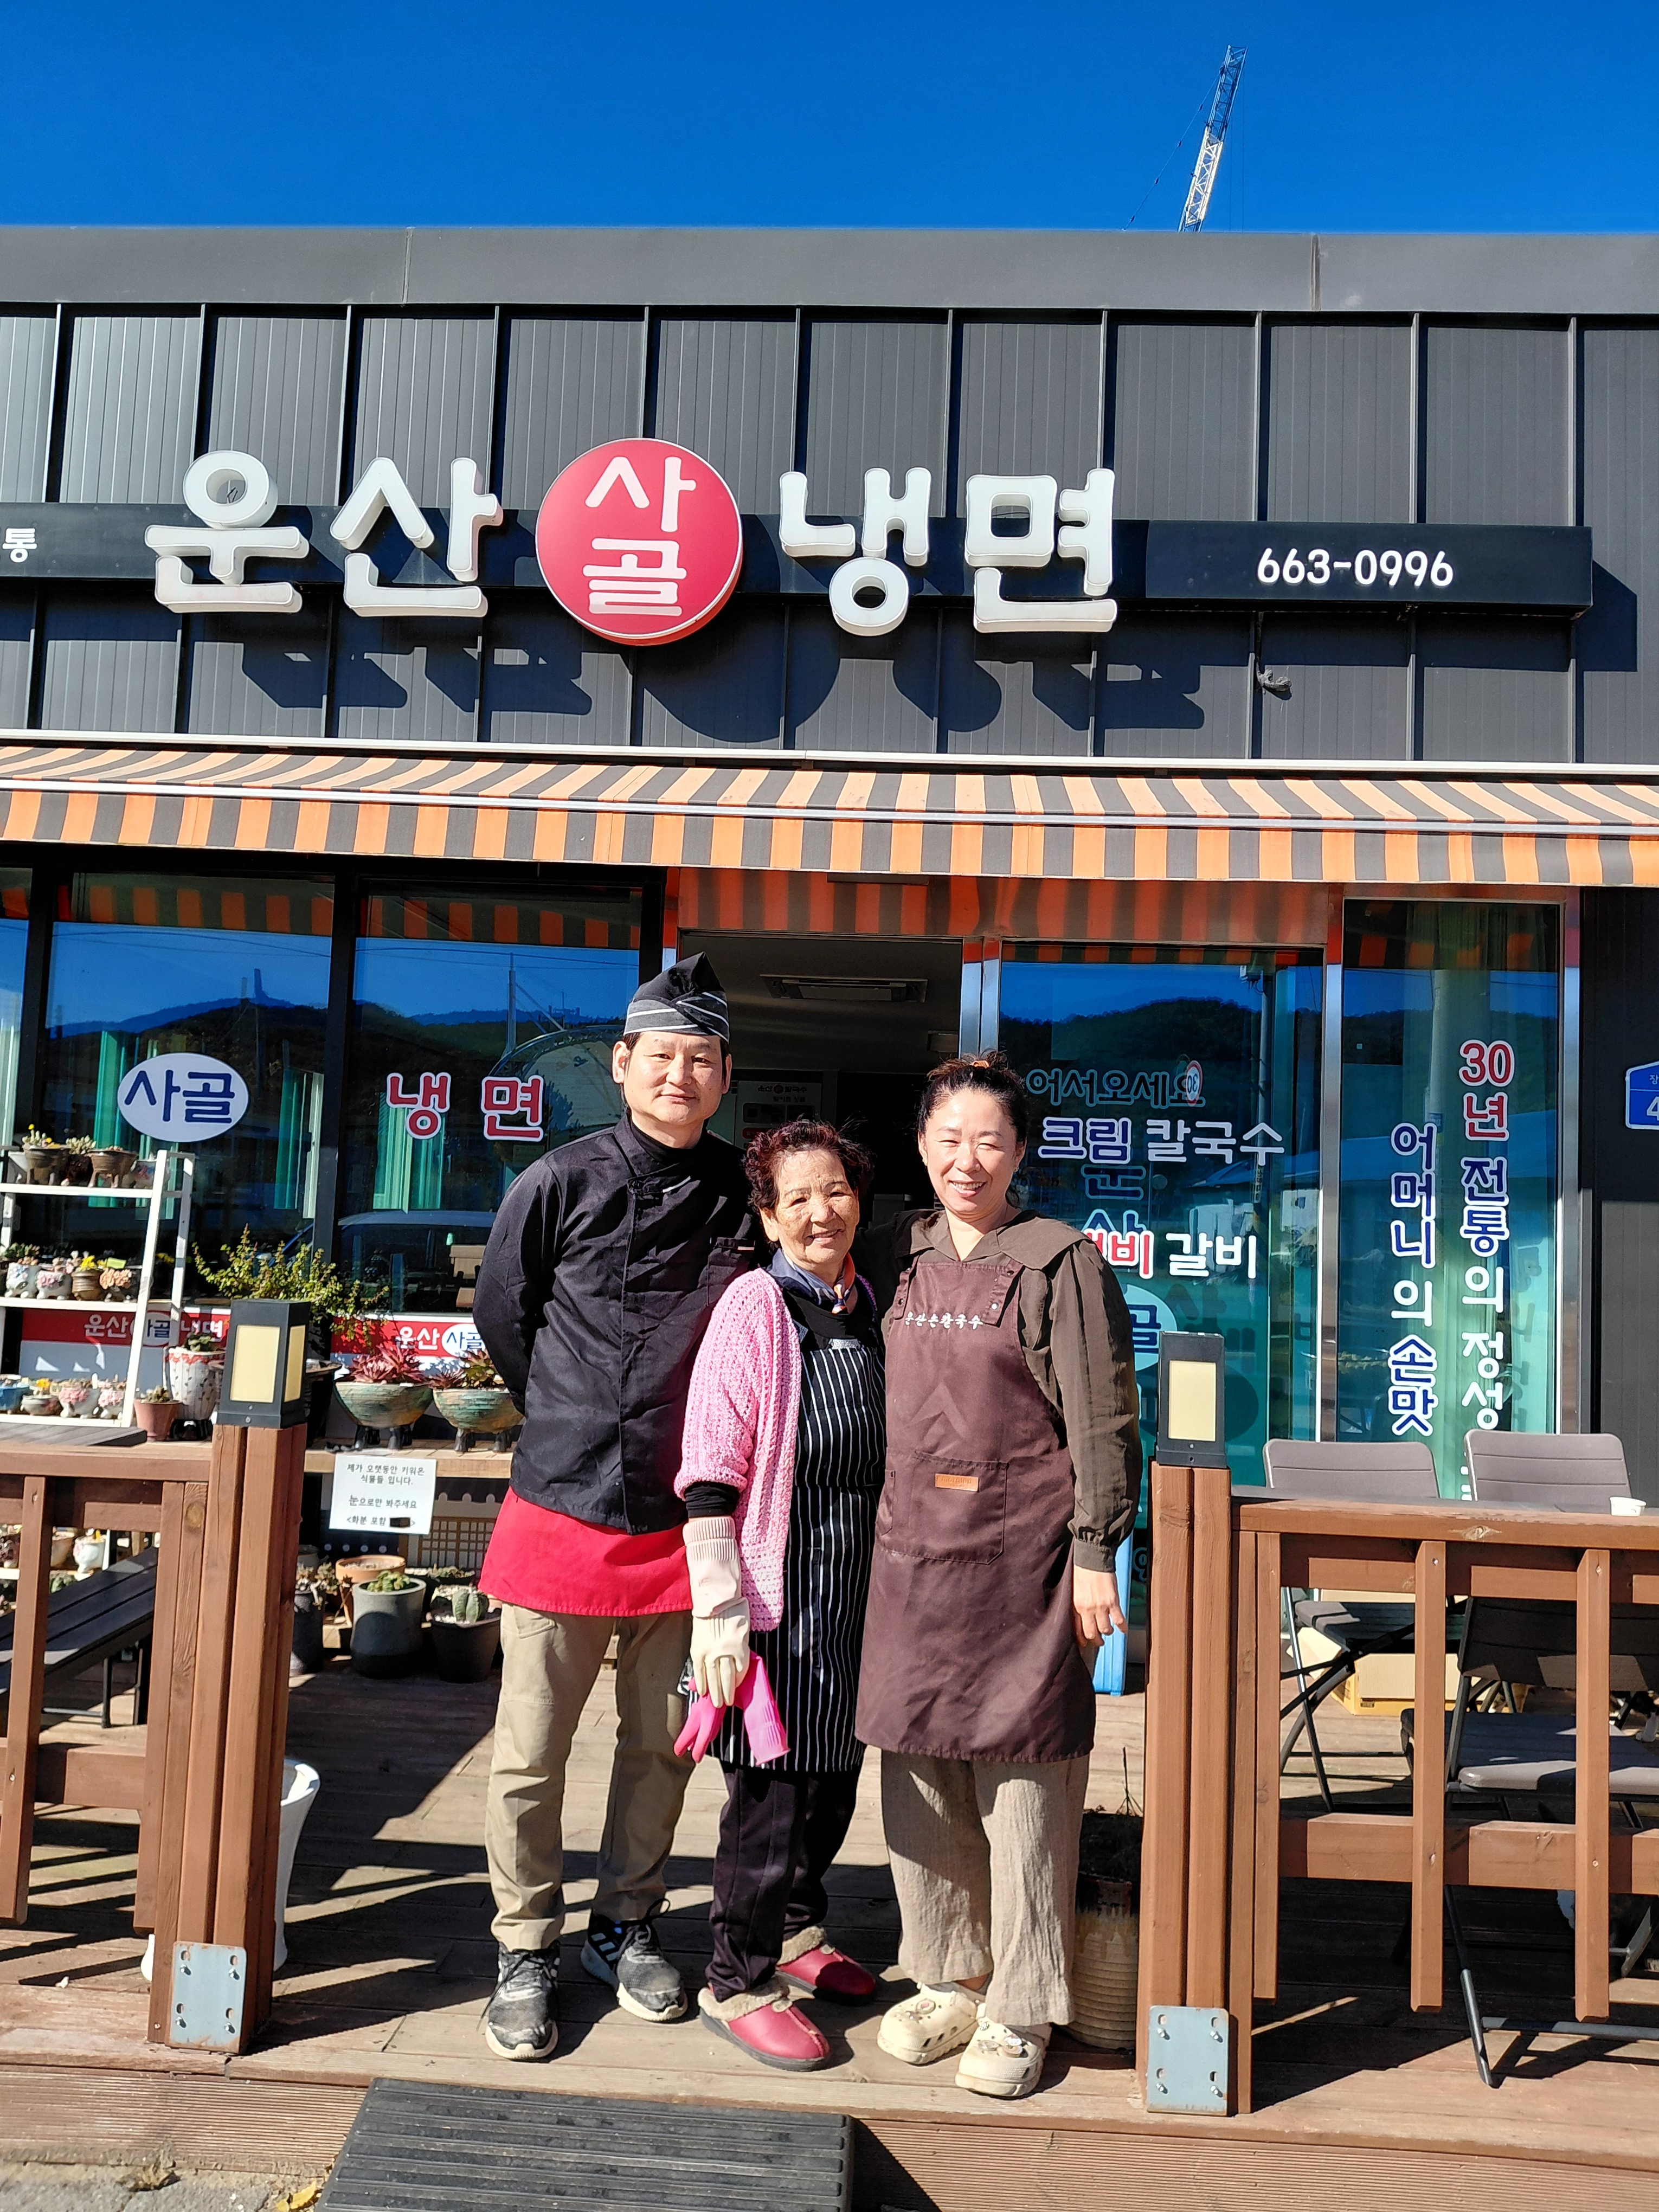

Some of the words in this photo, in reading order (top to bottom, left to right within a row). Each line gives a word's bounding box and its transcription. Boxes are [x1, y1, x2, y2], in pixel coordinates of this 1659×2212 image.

[3, 528, 37, 562] 통
[144, 450, 503, 617] 운산
[583, 456, 696, 616] 사골
[779, 467, 1117, 635] 냉면
[1257, 548, 1454, 588] 663-0996
[125, 1070, 234, 1123] 사골
[1026, 1068, 1206, 1109] 어서오세요
[1038, 1117, 1132, 1165] 크림
[1147, 1119, 1284, 1166] 칼국수
[1166, 1232, 1256, 1278] 갈비
[84, 1314, 129, 1338] 운산
[395, 1326, 440, 1350] 운산
[1388, 1334, 1439, 1437] 손맛
[1462, 1332, 1504, 1430] 정성
[347, 1464, 363, 1473] 제가
[361, 1474, 384, 1484] 식물들
[349, 1495, 382, 1507] 눈으로만
[385, 1499, 417, 1509] 봐주세요
